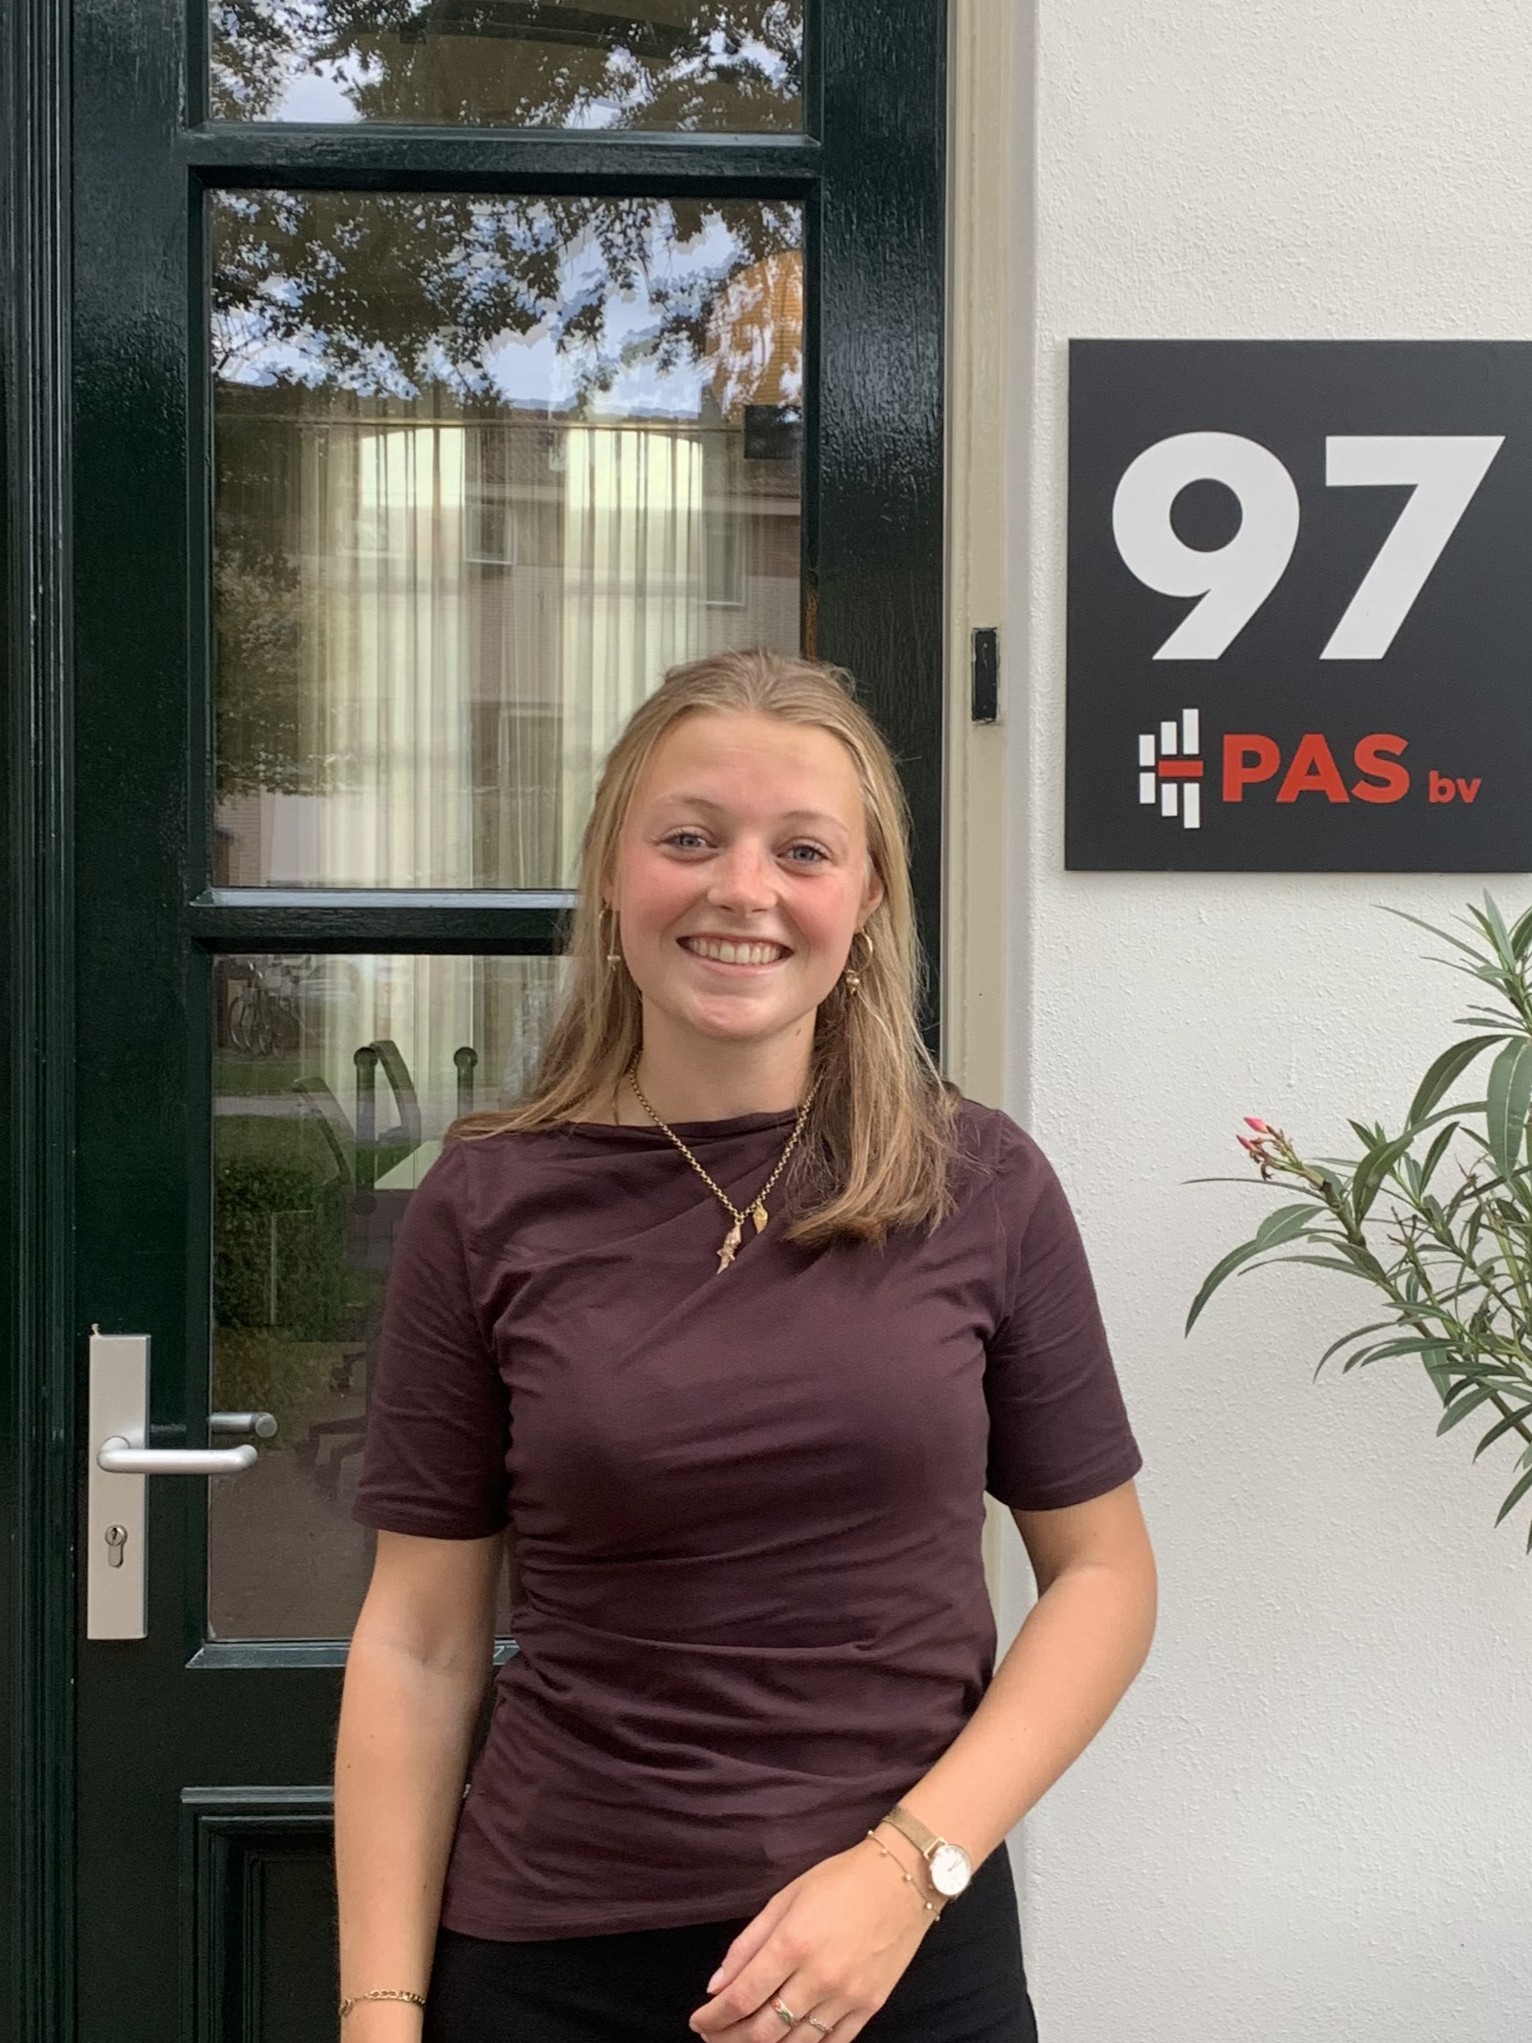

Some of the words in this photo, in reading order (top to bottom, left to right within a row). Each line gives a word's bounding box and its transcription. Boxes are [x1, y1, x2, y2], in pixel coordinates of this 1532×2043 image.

[1112, 431, 1506, 661] 97
[1222, 733, 1411, 804] PAS
[1428, 770, 1482, 803] bv
